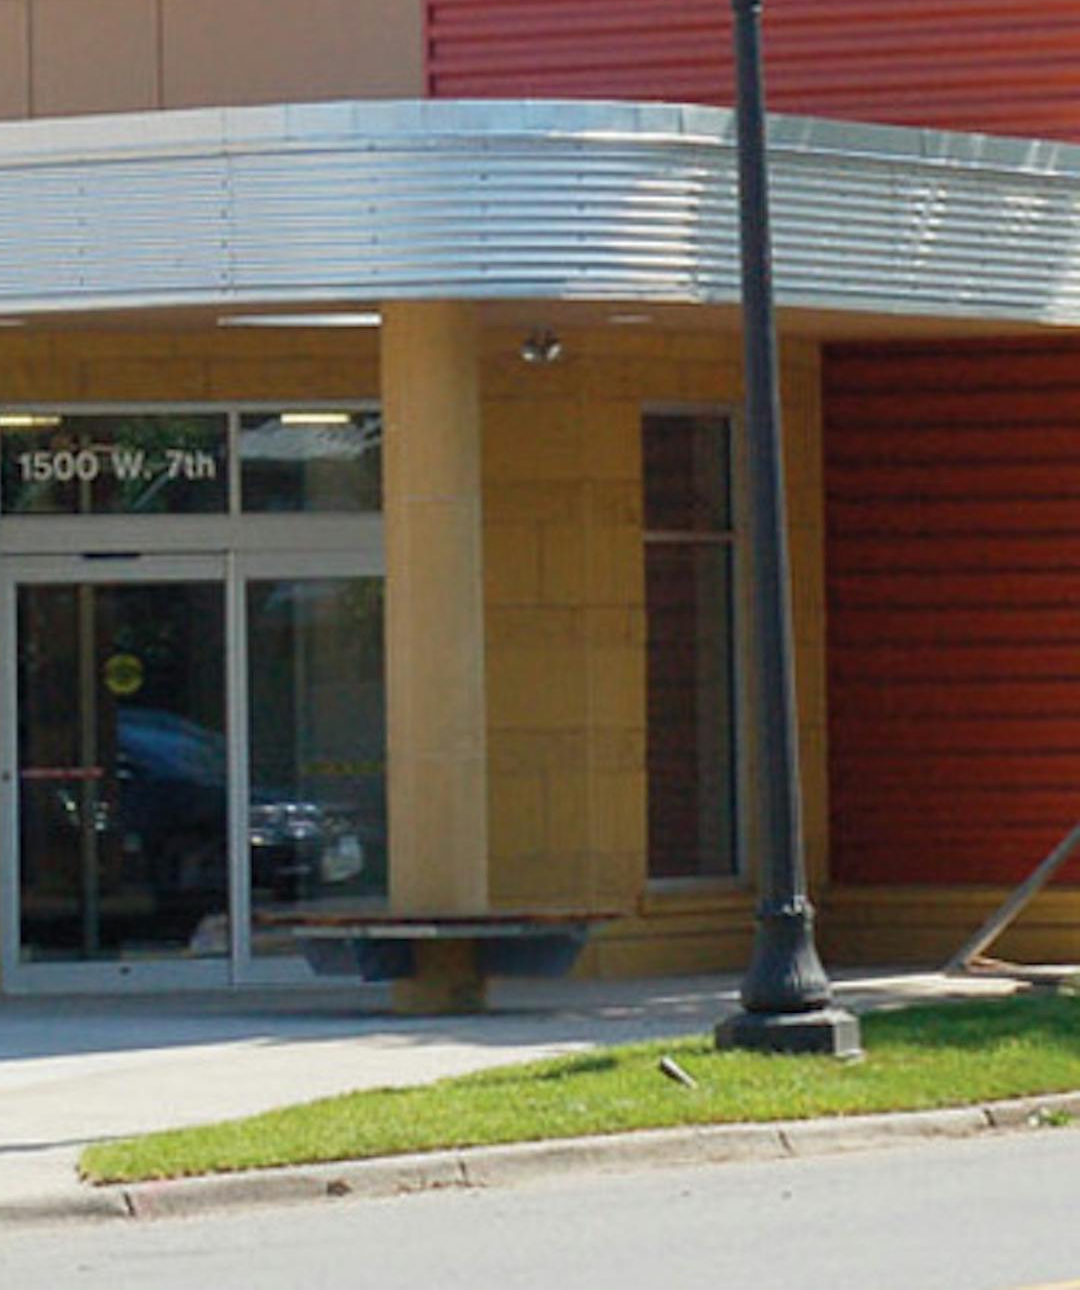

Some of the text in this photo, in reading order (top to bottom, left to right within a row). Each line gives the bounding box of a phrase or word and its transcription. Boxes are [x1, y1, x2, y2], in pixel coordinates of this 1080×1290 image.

[18, 448, 217, 482] 1500 W. 7th
